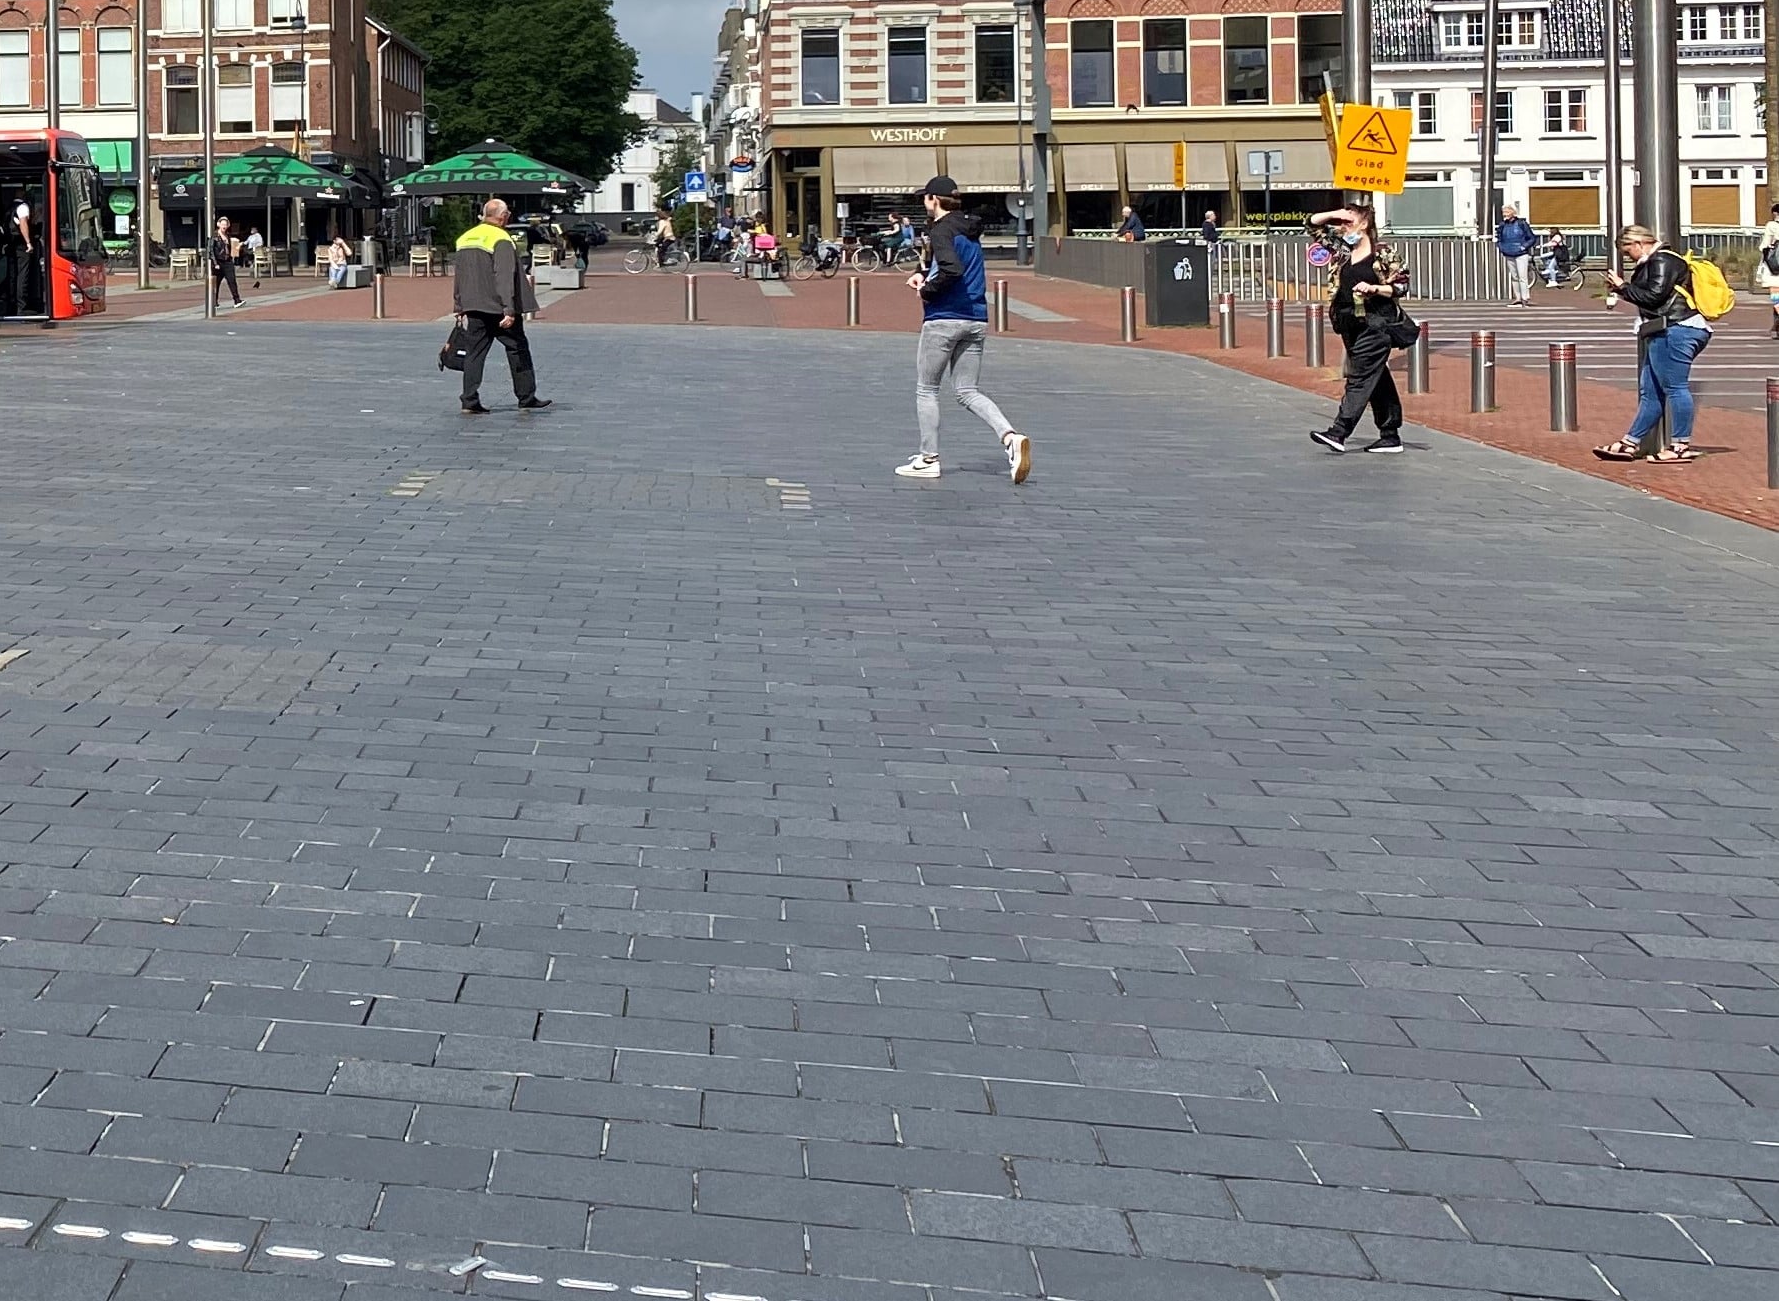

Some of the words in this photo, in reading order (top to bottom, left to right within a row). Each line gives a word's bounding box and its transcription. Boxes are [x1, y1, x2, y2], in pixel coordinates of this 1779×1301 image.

[870, 127, 947, 142] WESTHOFF
[1355, 158, 1384, 170] Glad
[1261, 182, 1336, 190] WERKPLEKKE
[1344, 175, 1390, 186] wegdek
[1147, 183, 1210, 191] SANDCHES
